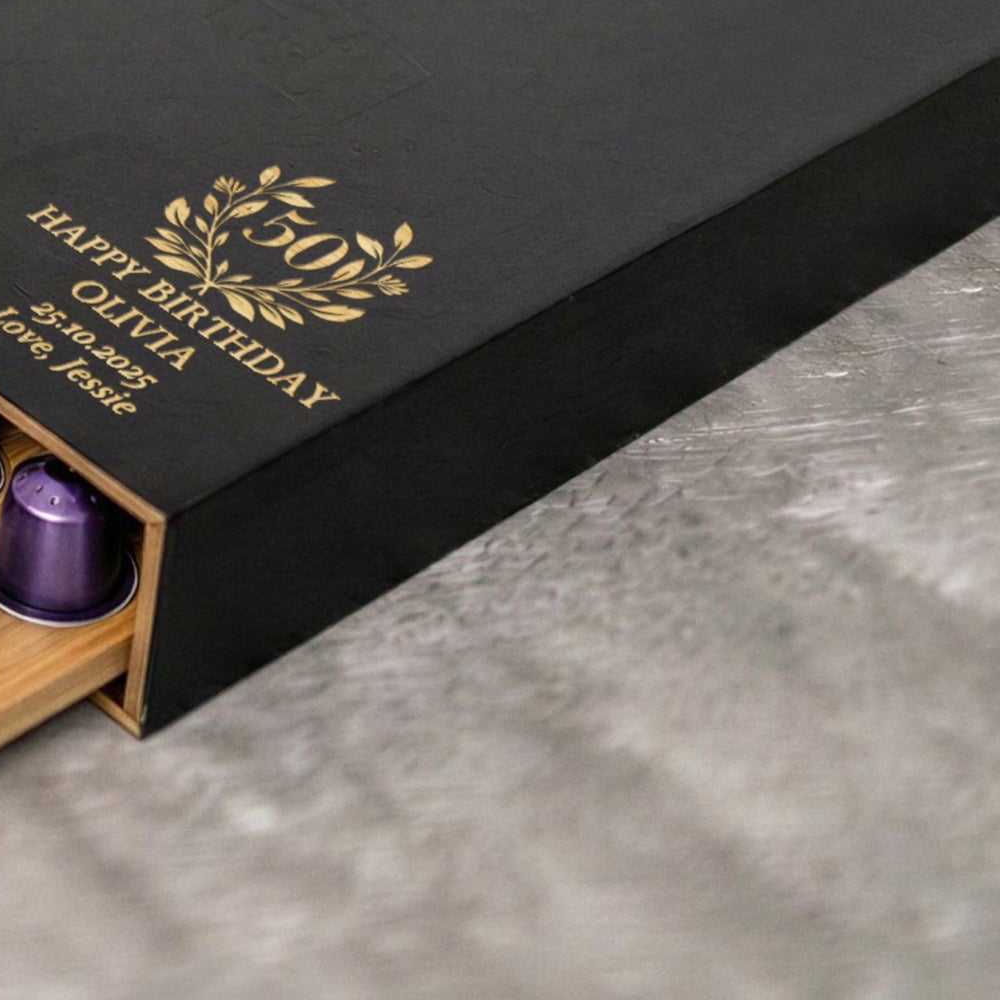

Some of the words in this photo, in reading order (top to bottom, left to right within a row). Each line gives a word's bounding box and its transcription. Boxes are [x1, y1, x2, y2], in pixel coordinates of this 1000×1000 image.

[242, 209, 349, 271] 50
[27, 203, 151, 281] HAPPY
[138, 279, 340, 409] BIRTHDAY
[29, 302, 159, 391] 25.10.2025
[71, 280, 196, 371] OLIVIA
[49, 357, 137, 415] Jessie
